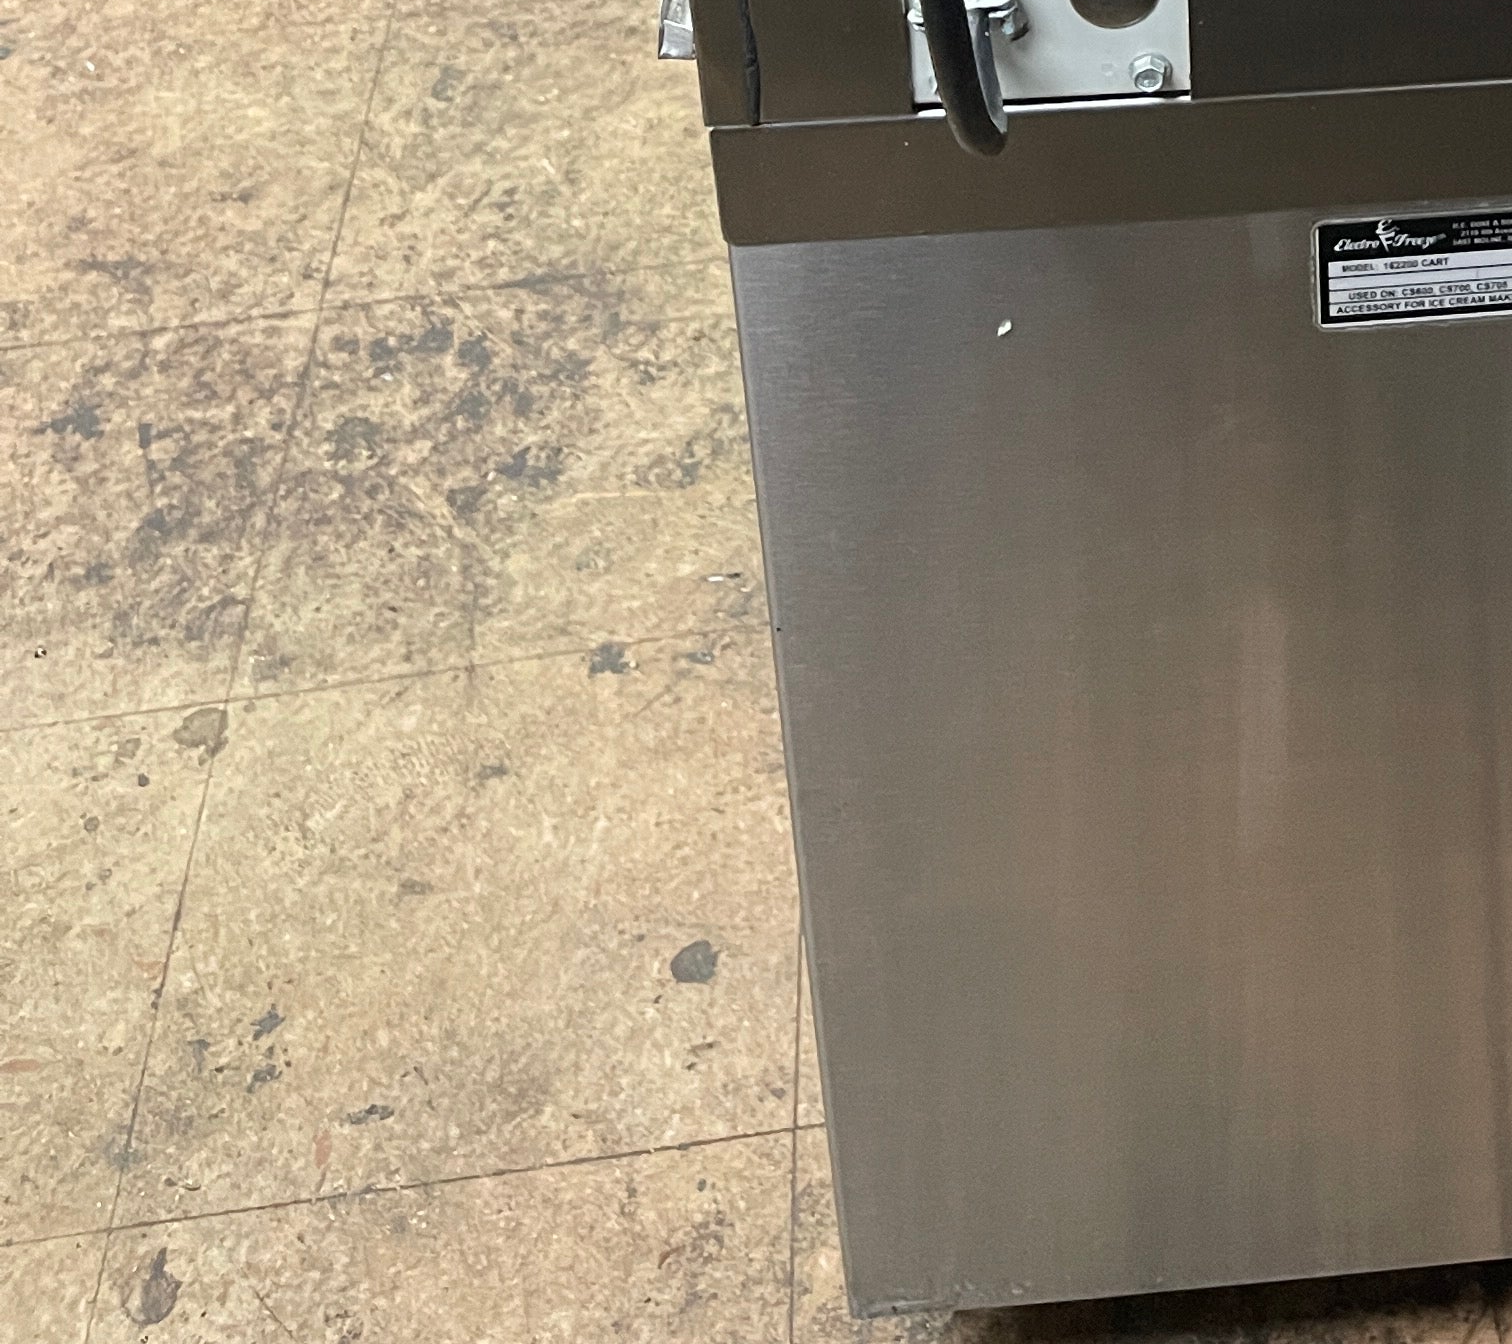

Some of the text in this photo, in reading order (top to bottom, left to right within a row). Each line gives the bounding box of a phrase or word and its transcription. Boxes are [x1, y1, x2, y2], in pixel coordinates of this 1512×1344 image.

[1421, 257, 1449, 267] CART
[1348, 290, 1377, 300] USED
[1336, 302, 1402, 314] ACCESSORY
[1404, 300, 1426, 309] FOR
[1428, 299, 1444, 308] ICE
[1448, 295, 1485, 306] CREAM
